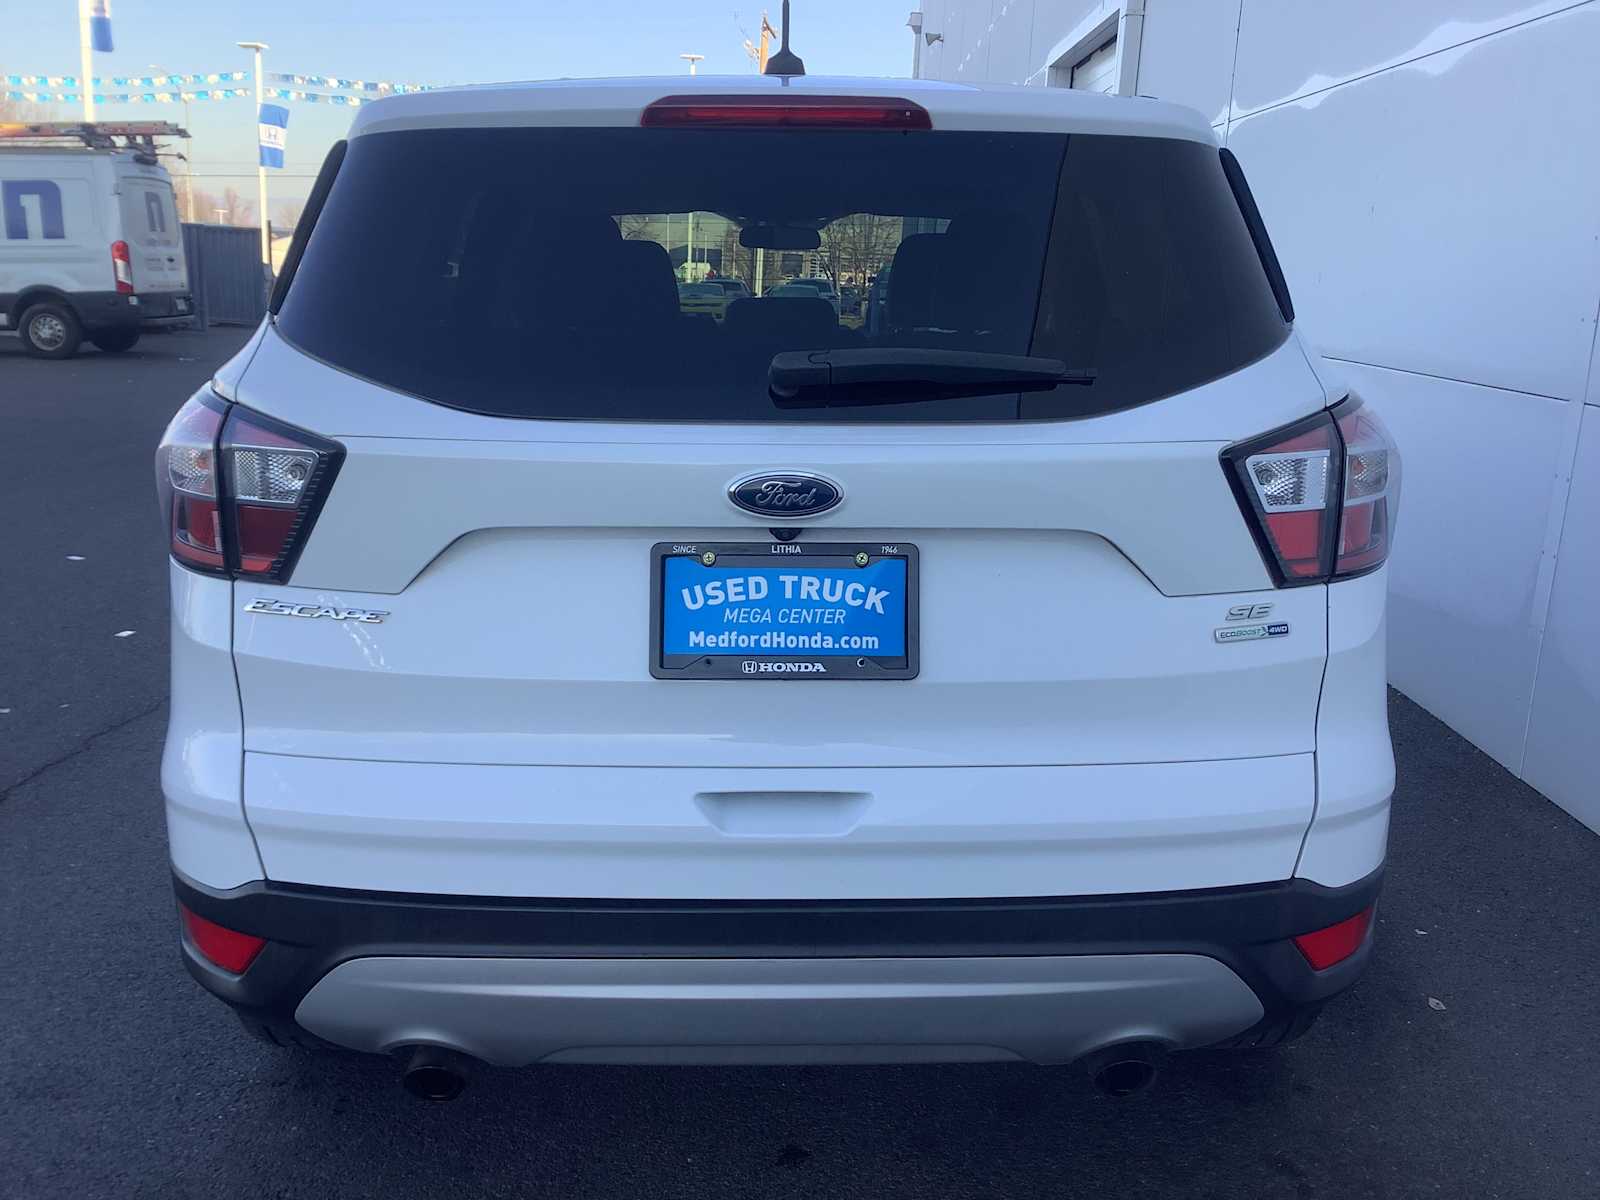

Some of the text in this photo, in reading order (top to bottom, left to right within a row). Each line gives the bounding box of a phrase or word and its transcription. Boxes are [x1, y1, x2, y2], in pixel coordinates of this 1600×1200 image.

[755, 481, 817, 506] Ford
[672, 545, 697, 553] SINCE
[771, 545, 802, 554] LITHIA
[881, 546, 898, 554] 1946
[681, 575, 890, 615] USED TRUCK
[244, 599, 390, 623] ESCAPE
[723, 608, 846, 624] MEGA CENTER
[1225, 602, 1274, 621] SE
[1269, 624, 1287, 634] 4WD
[689, 631, 879, 649] MedfordHonda.com
[758, 662, 827, 673] HONDA
